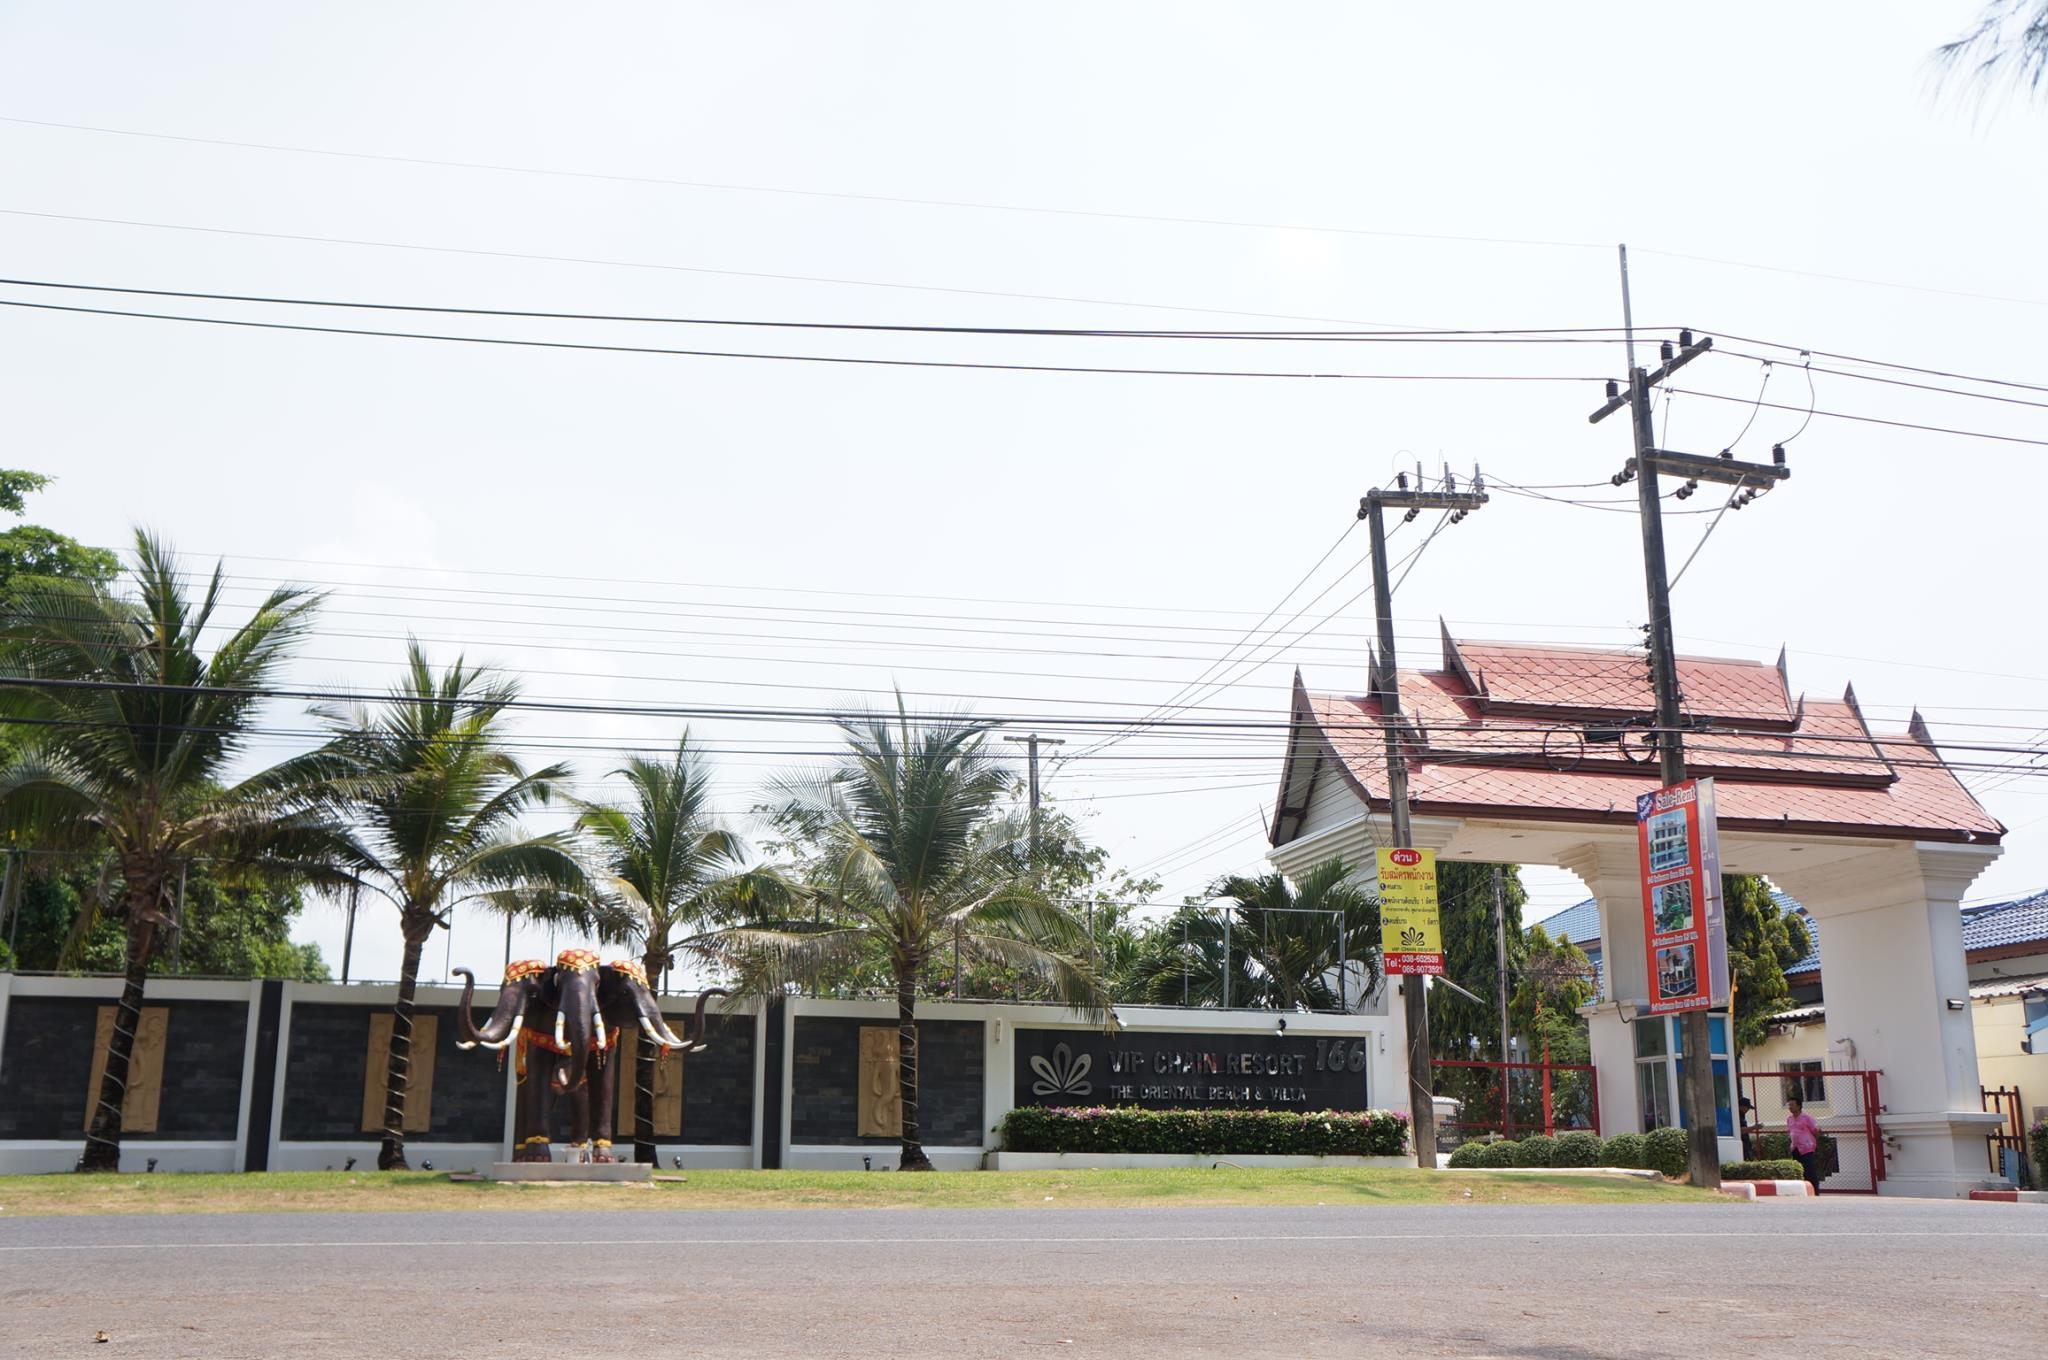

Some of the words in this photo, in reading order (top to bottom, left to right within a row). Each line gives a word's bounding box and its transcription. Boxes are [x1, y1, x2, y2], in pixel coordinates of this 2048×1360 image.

[1393, 851, 1412, 862] ด่วน
[1380, 867, 1434, 880] รับสมัครพนักงาน
[1108, 1050, 1144, 1072] VIP
[1154, 1050, 1217, 1074] CHAIN
[1226, 1052, 1306, 1075] RESORT
[1316, 1040, 1365, 1072] 166
[1109, 1085, 1133, 1099] THE
[1139, 1085, 1201, 1100] ORIENTAL
[1208, 1086, 1250, 1100] BEACH
[1254, 1087, 1262, 1101] &
[1270, 1087, 1307, 1101] VILLA
